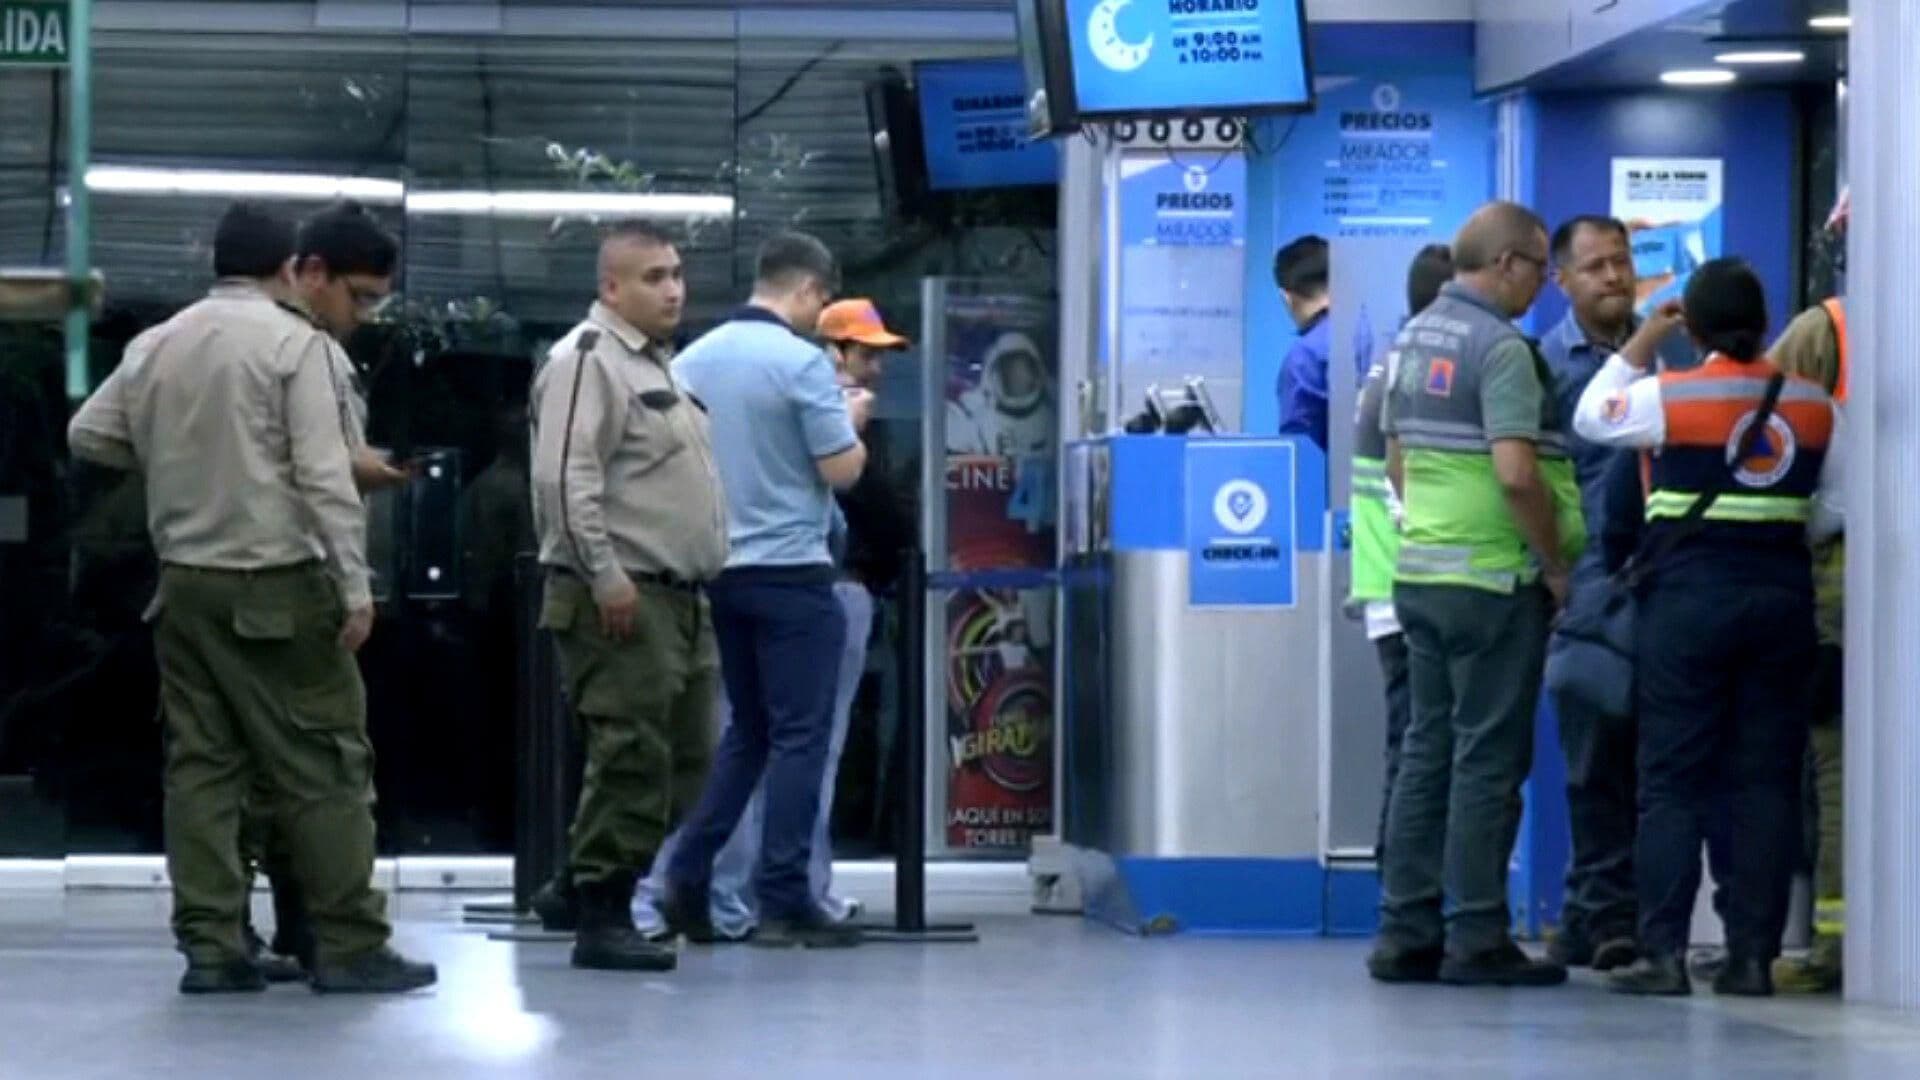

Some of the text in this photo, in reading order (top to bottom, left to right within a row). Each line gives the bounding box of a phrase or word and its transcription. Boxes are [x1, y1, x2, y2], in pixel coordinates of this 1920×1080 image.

[0, 8, 65, 54] IDA
[1193, 32, 1236, 46] 9:00
[1191, 48, 1240, 63] 10:00
[1340, 112, 1431, 130] PRECIOS
[1341, 143, 1430, 160] MIRADOR
[1157, 192, 1234, 209] PRECIOS
[946, 465, 1009, 489] CINE
[1203, 546, 1280, 561] CHECK-IN
